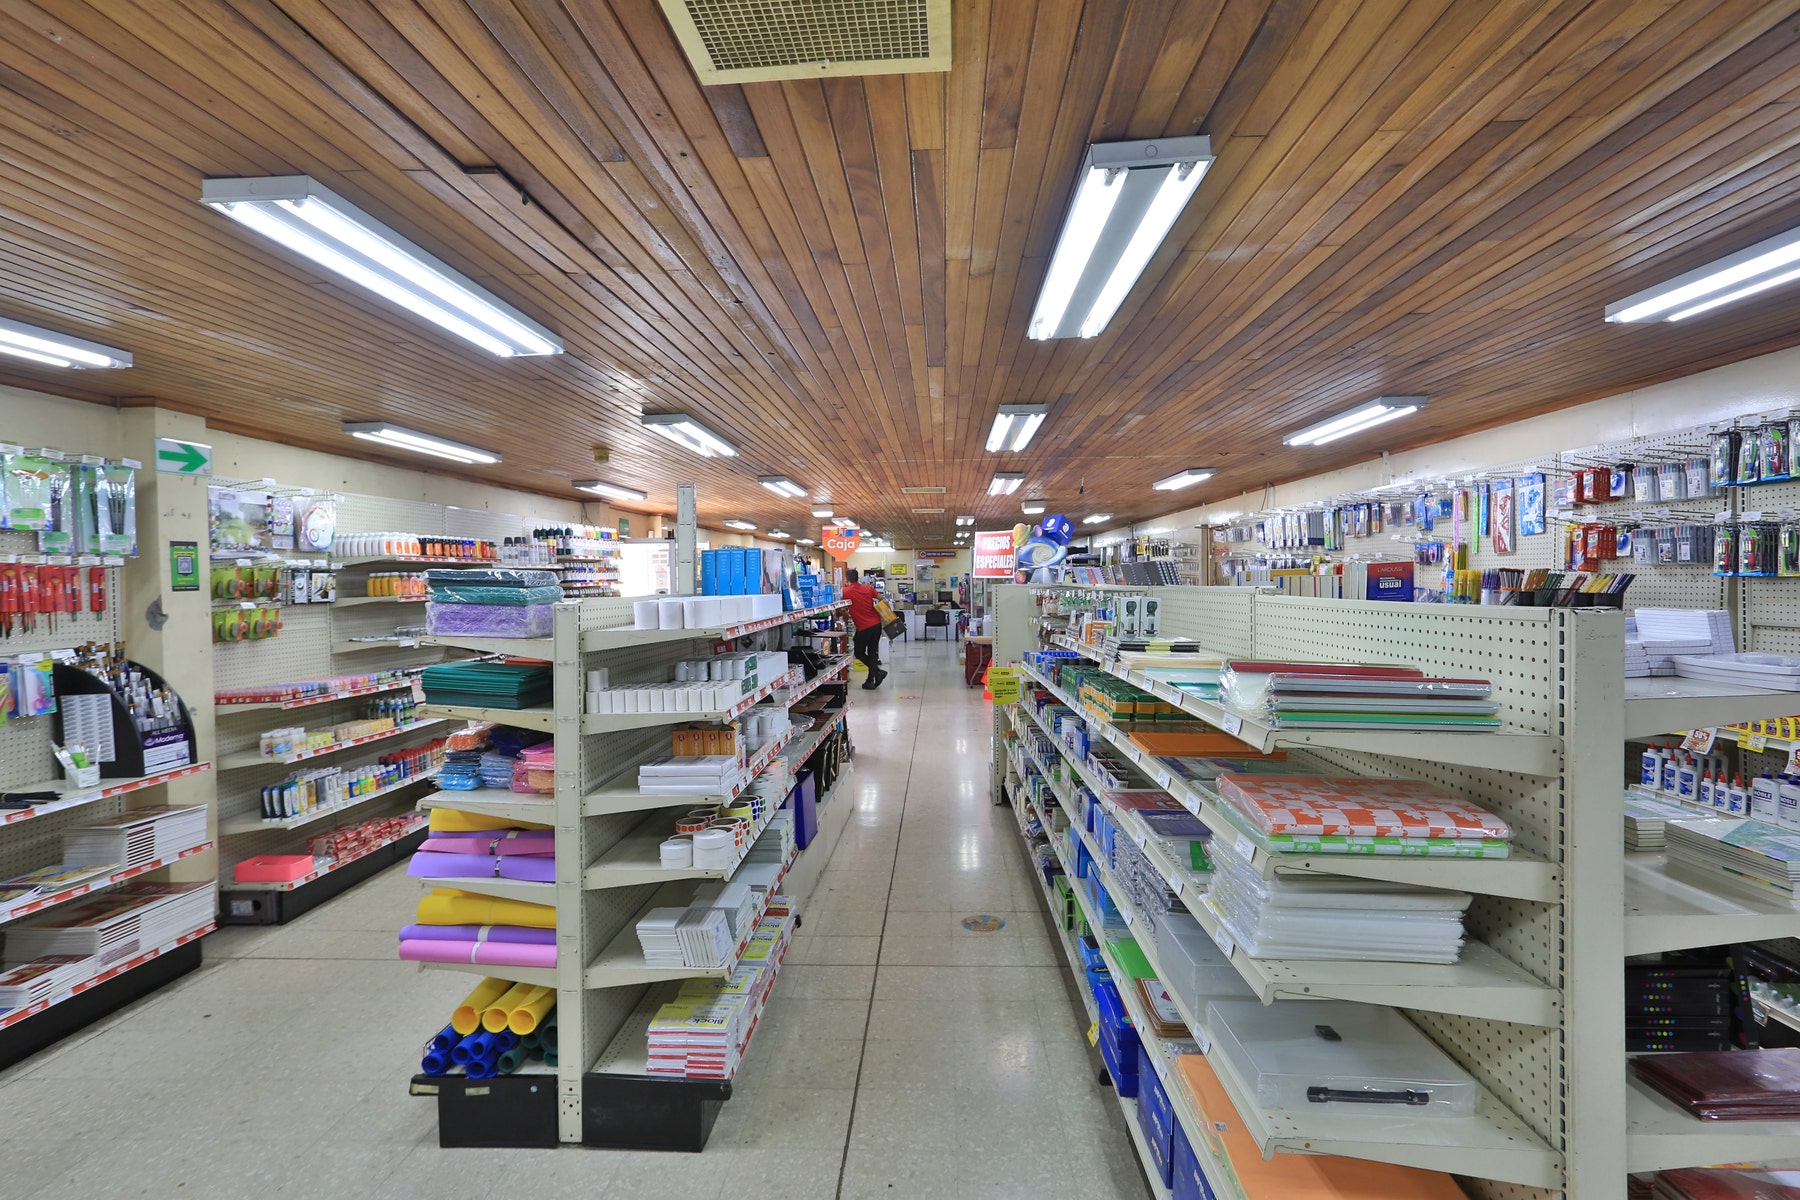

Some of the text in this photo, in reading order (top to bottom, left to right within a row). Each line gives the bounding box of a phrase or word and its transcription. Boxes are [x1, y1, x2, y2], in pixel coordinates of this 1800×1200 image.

[827, 539, 856, 551] Caja
[982, 535, 1011, 550] PRECIOS
[976, 554, 1014, 569] ESPECIALES
[1379, 580, 1402, 589] usual
[1694, 730, 1709, 741] 50%
[1754, 790, 1771, 799] NOBLE
[693, 1017, 724, 1025] Block
